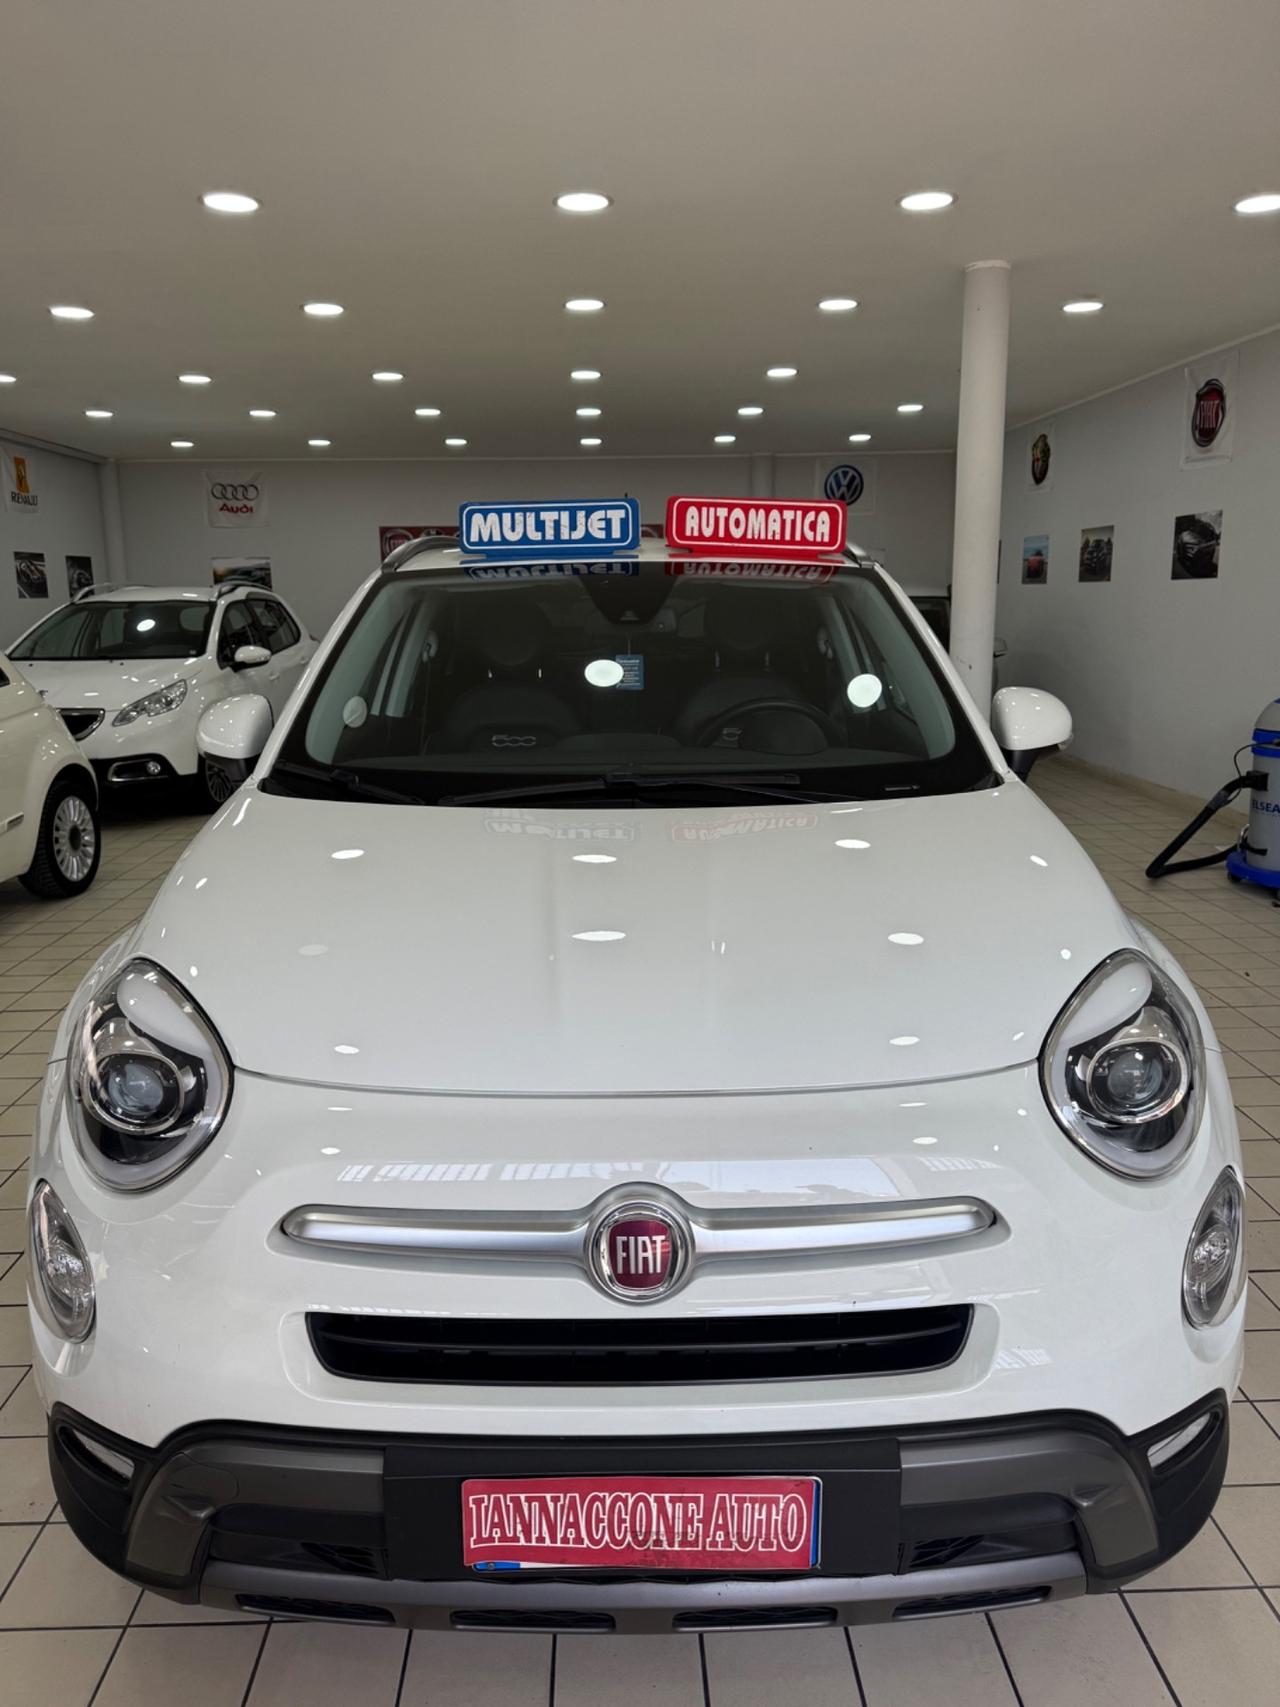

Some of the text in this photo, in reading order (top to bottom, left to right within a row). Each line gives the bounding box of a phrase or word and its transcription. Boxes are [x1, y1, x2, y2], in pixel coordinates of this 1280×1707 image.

[219, 503, 253, 513] Audi
[470, 509, 626, 542] MULTIJET
[685, 506, 830, 543] AUTOMATICA
[616, 1235, 666, 1274] FIAT
[469, 1492, 808, 1552] IANNACCONE AUTO
